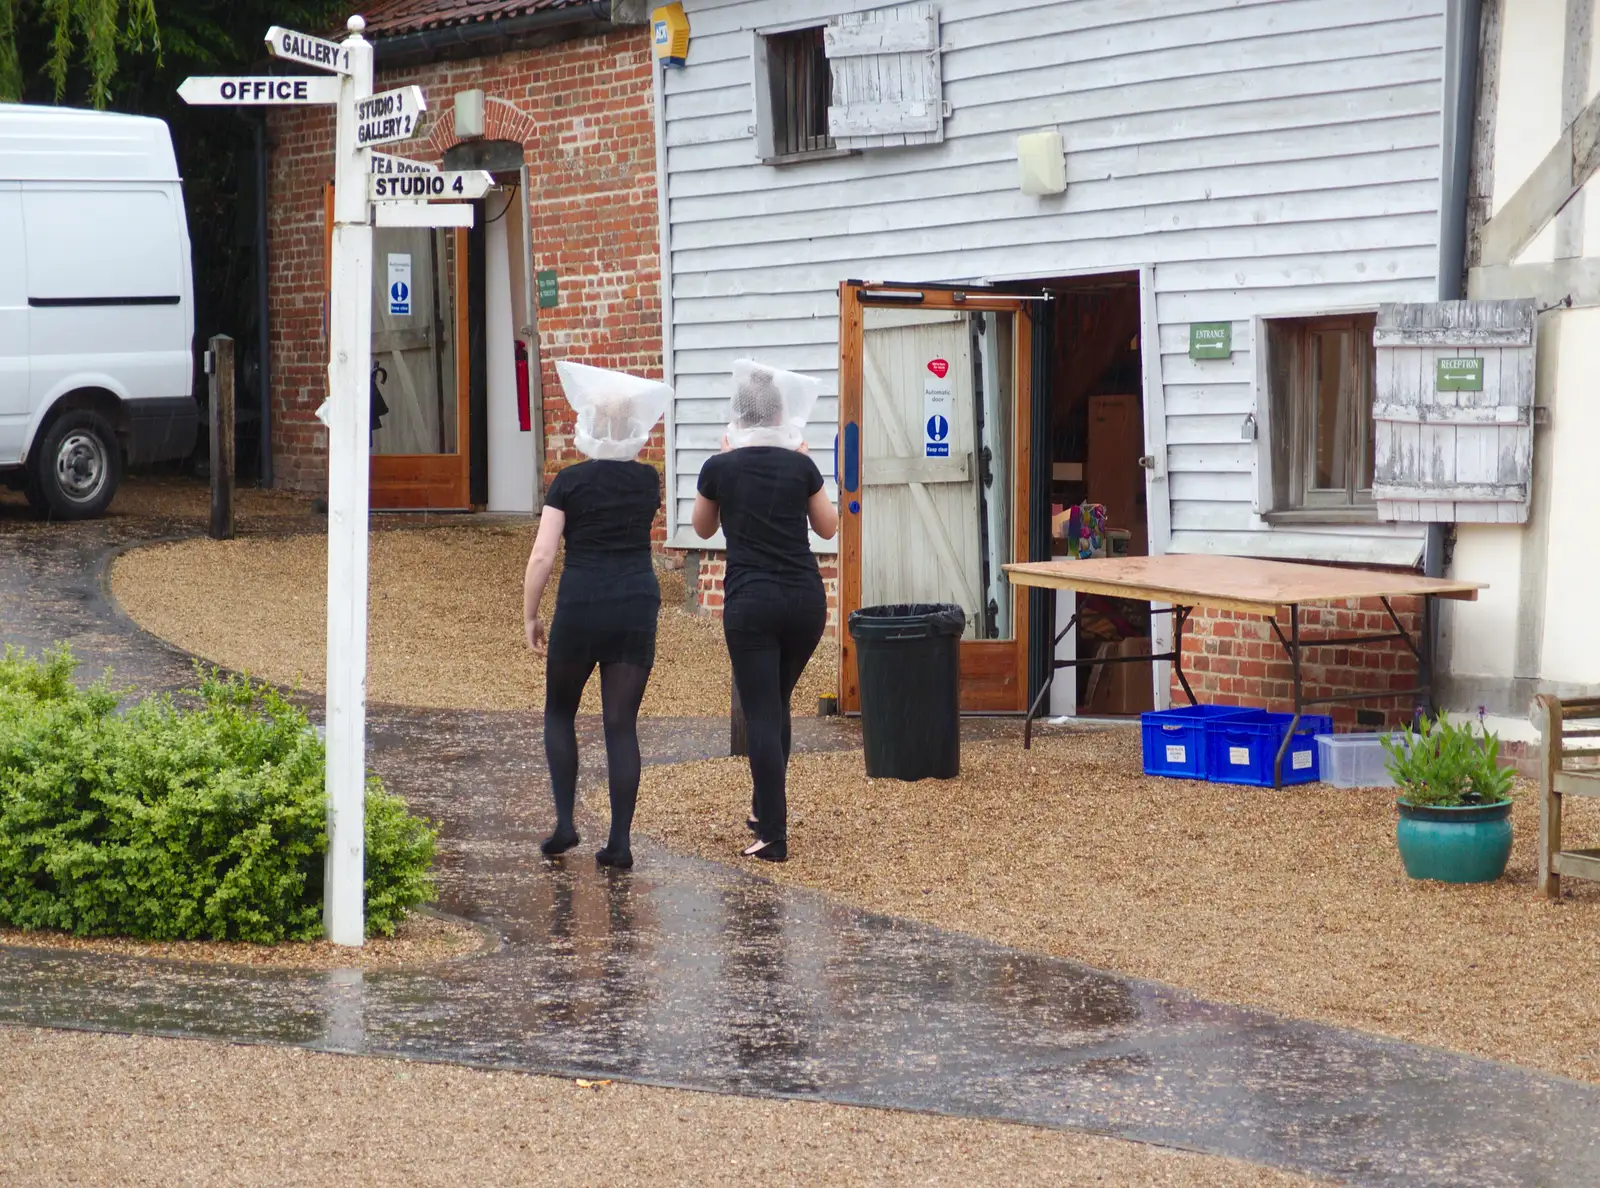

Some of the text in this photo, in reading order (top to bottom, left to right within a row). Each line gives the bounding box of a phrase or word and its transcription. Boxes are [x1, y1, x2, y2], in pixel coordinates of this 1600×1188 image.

[282, 34, 349, 69] GALLERY 1
[220, 81, 307, 100] OFFICE
[358, 93, 403, 120] STUDIO 3
[358, 114, 411, 143] GALLERY 2
[371, 156, 431, 174] TEA RO
[375, 175, 464, 196] STUDIO 4
[1195, 329, 1225, 339] ENTRANCE
[1441, 359, 1479, 369] RECEPTION
